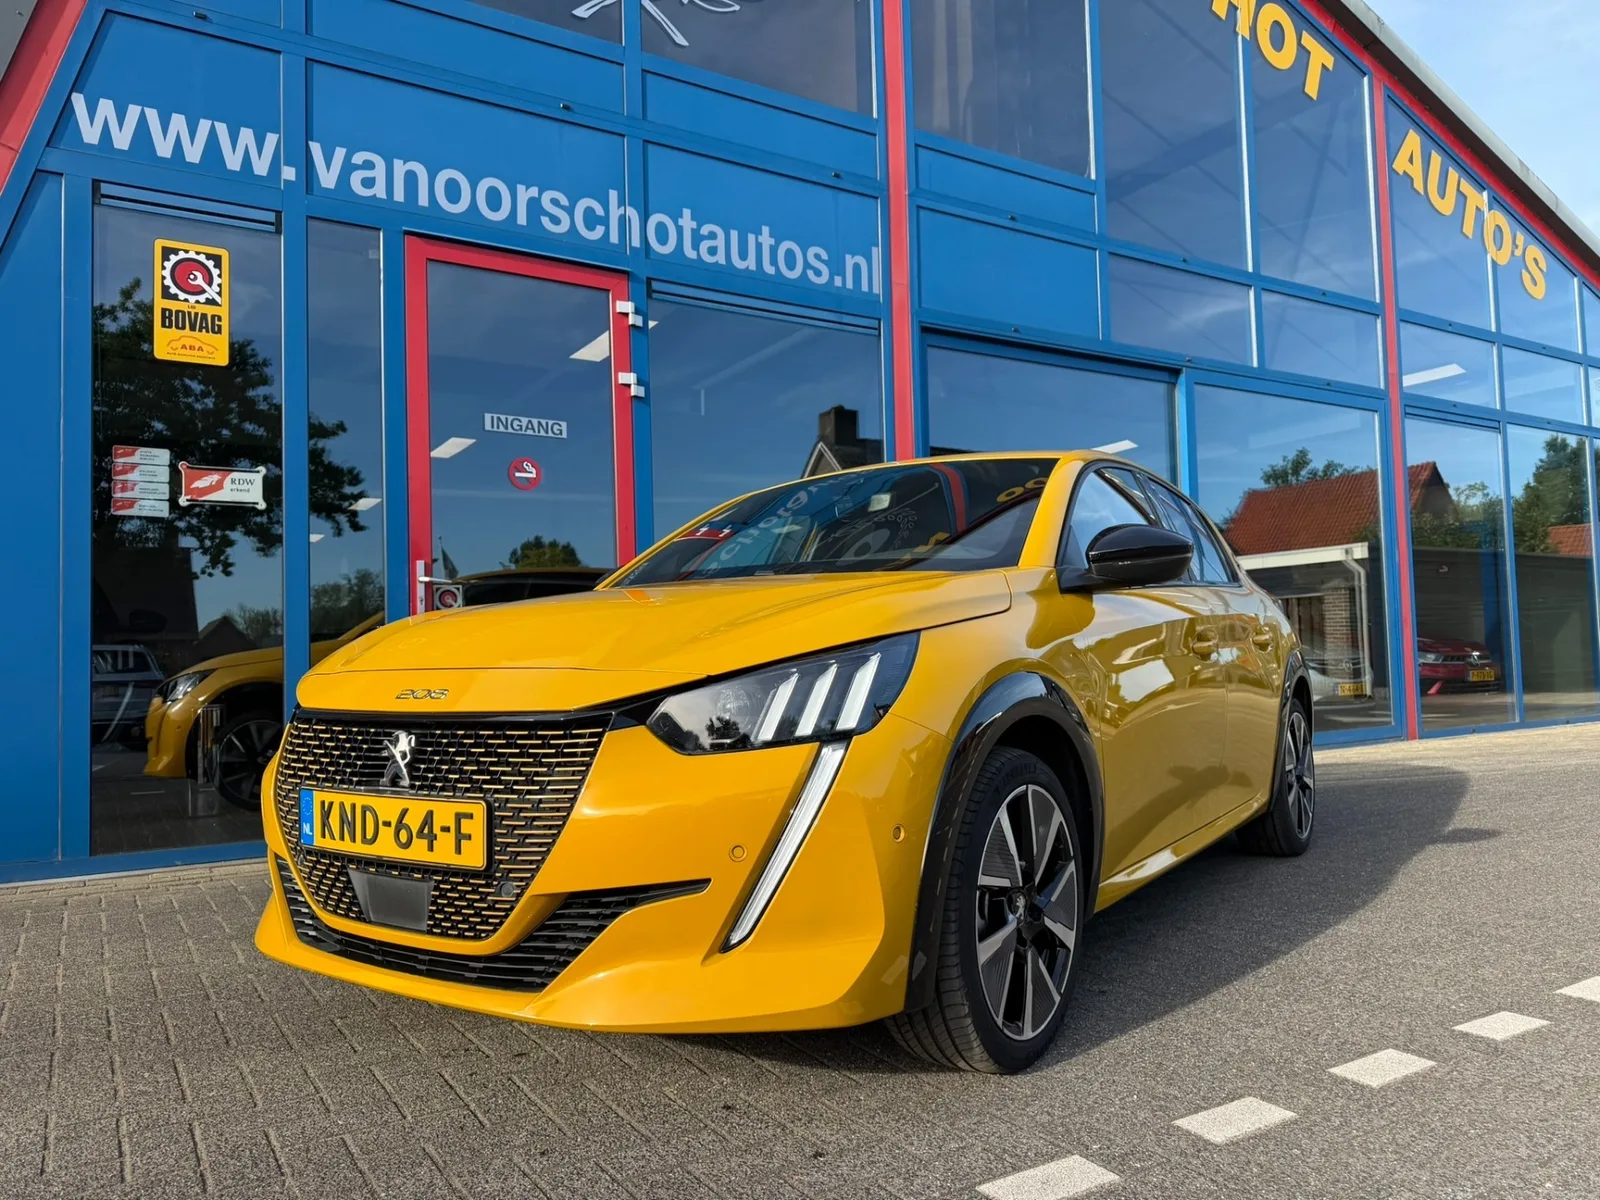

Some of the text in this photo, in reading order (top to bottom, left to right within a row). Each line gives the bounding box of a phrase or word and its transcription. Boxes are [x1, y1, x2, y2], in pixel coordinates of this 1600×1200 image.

[71, 92, 880, 295] www.vanoorschotautos.nl
[1392, 128, 1547, 300] AUTO'S
[161, 307, 223, 335] BOVAG
[180, 343, 205, 353] ABA
[490, 415, 563, 437] INGANG
[230, 477, 256, 486] RDW
[395, 688, 450, 700] 208
[302, 822, 313, 836] NL
[320, 799, 474, 856] KND-64-F
